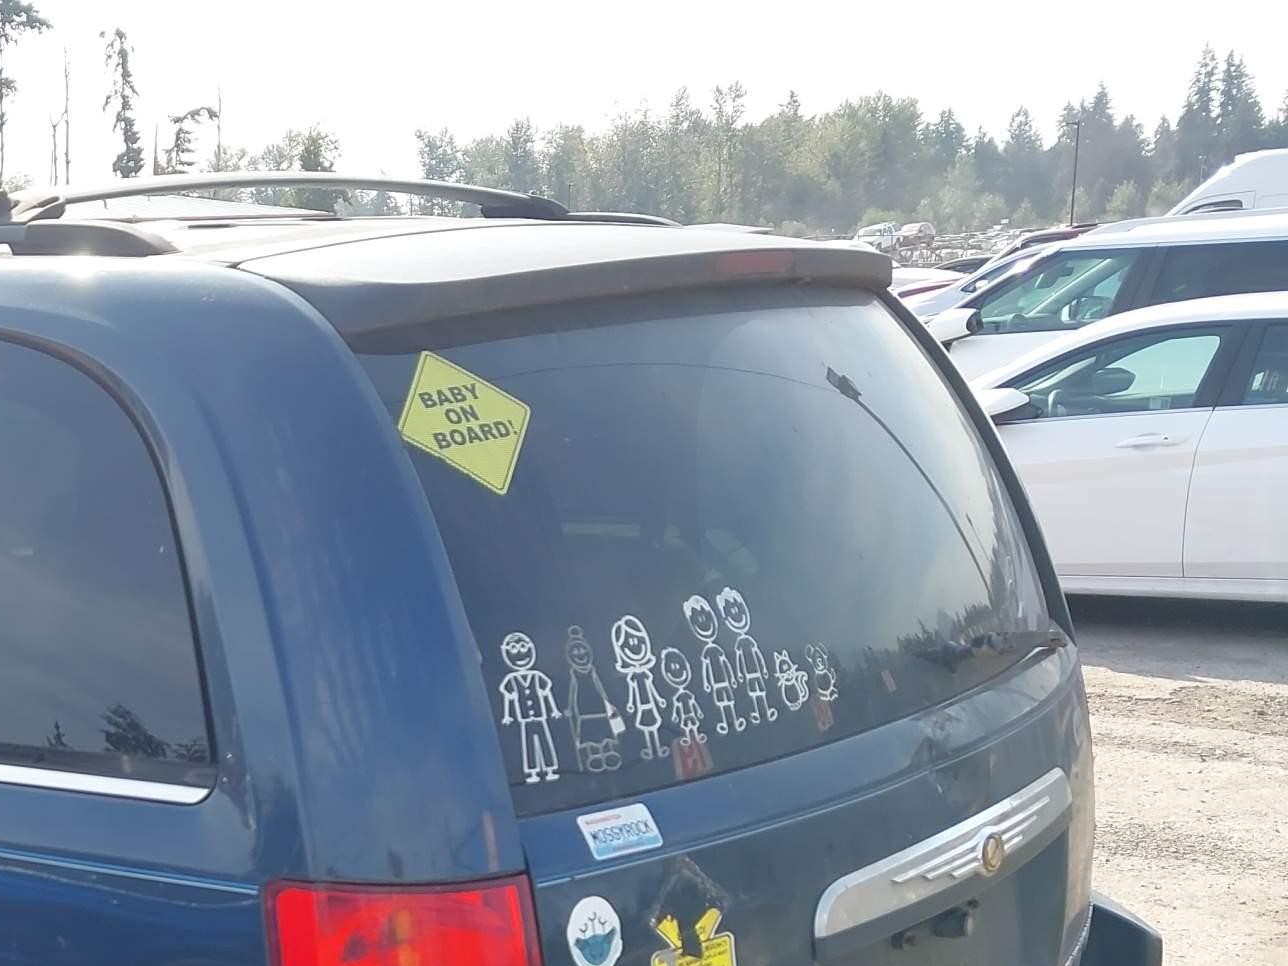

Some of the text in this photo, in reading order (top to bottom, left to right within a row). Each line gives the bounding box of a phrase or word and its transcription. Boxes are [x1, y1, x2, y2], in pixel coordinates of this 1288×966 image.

[418, 382, 480, 409] BABY
[444, 404, 481, 425] ON
[432, 419, 518, 450] BOARD!
